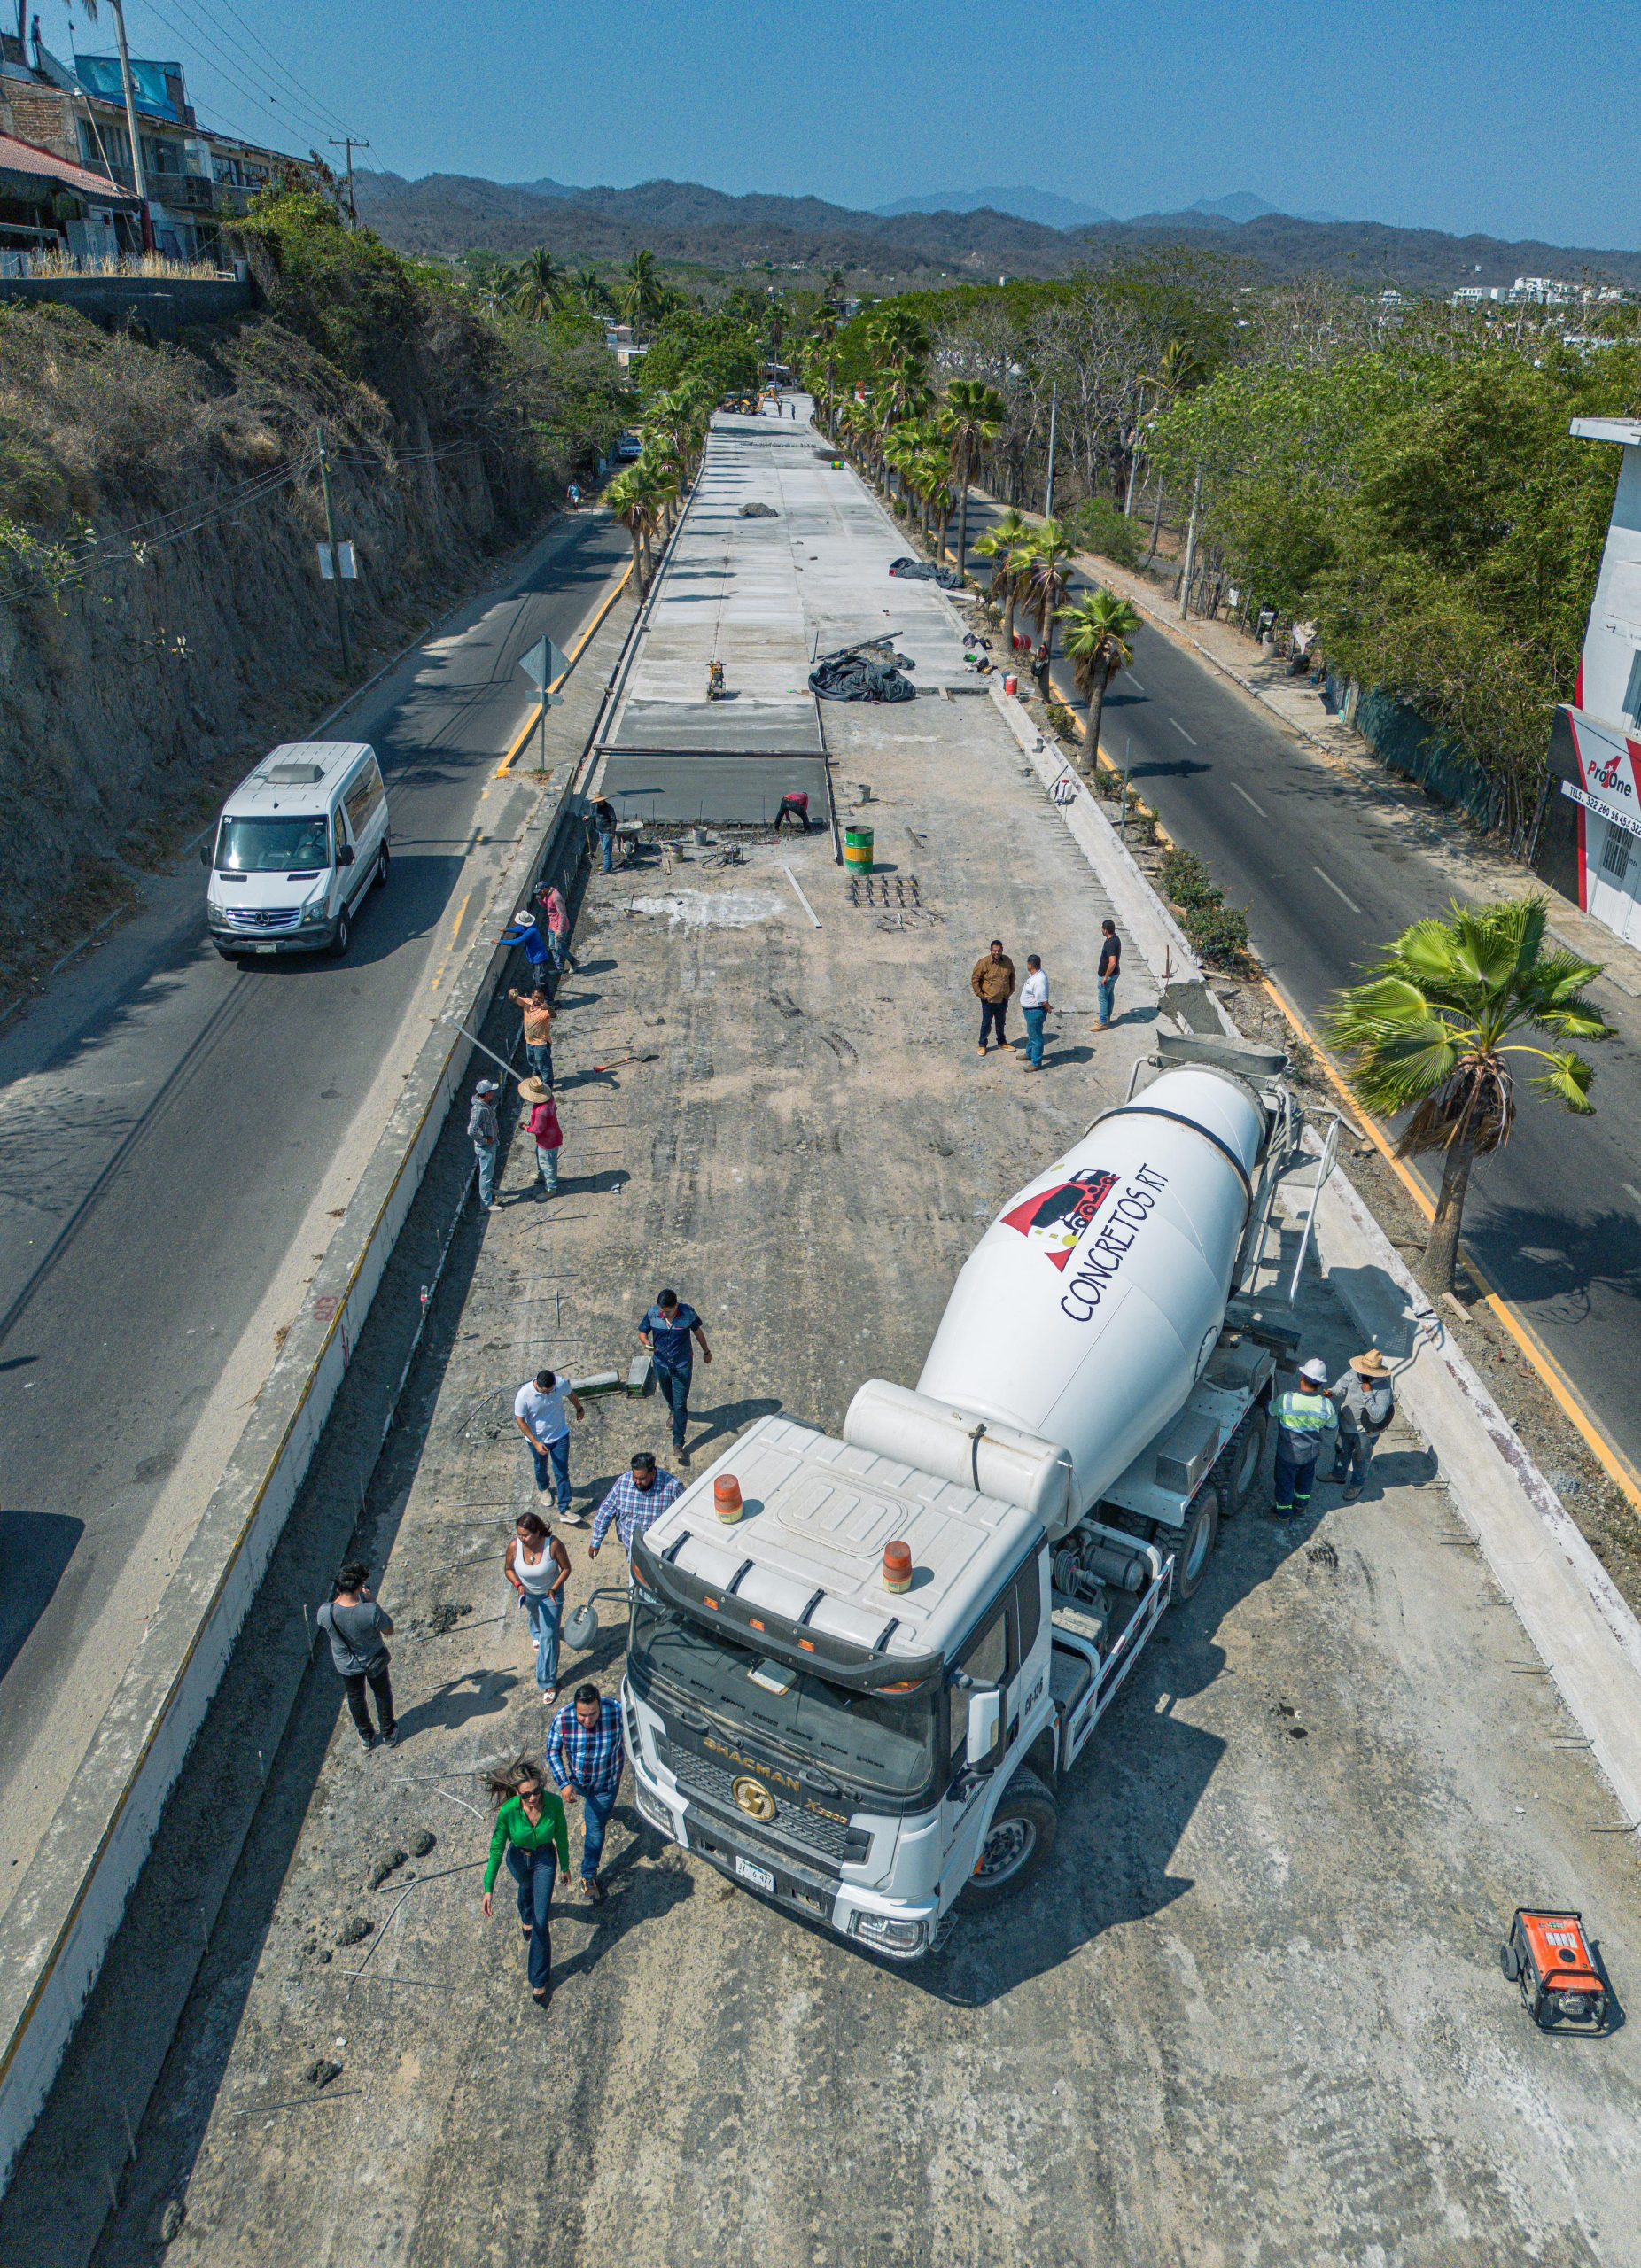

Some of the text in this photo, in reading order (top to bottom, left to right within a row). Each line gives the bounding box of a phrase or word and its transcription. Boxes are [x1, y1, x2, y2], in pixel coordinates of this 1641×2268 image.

[1587, 796, 1598, 810] 322
[1598, 804, 1610, 817] 260
[1061, 1162, 1169, 1322] CONCRETOS RT
[704, 1736, 801, 1792] SHACMAN
